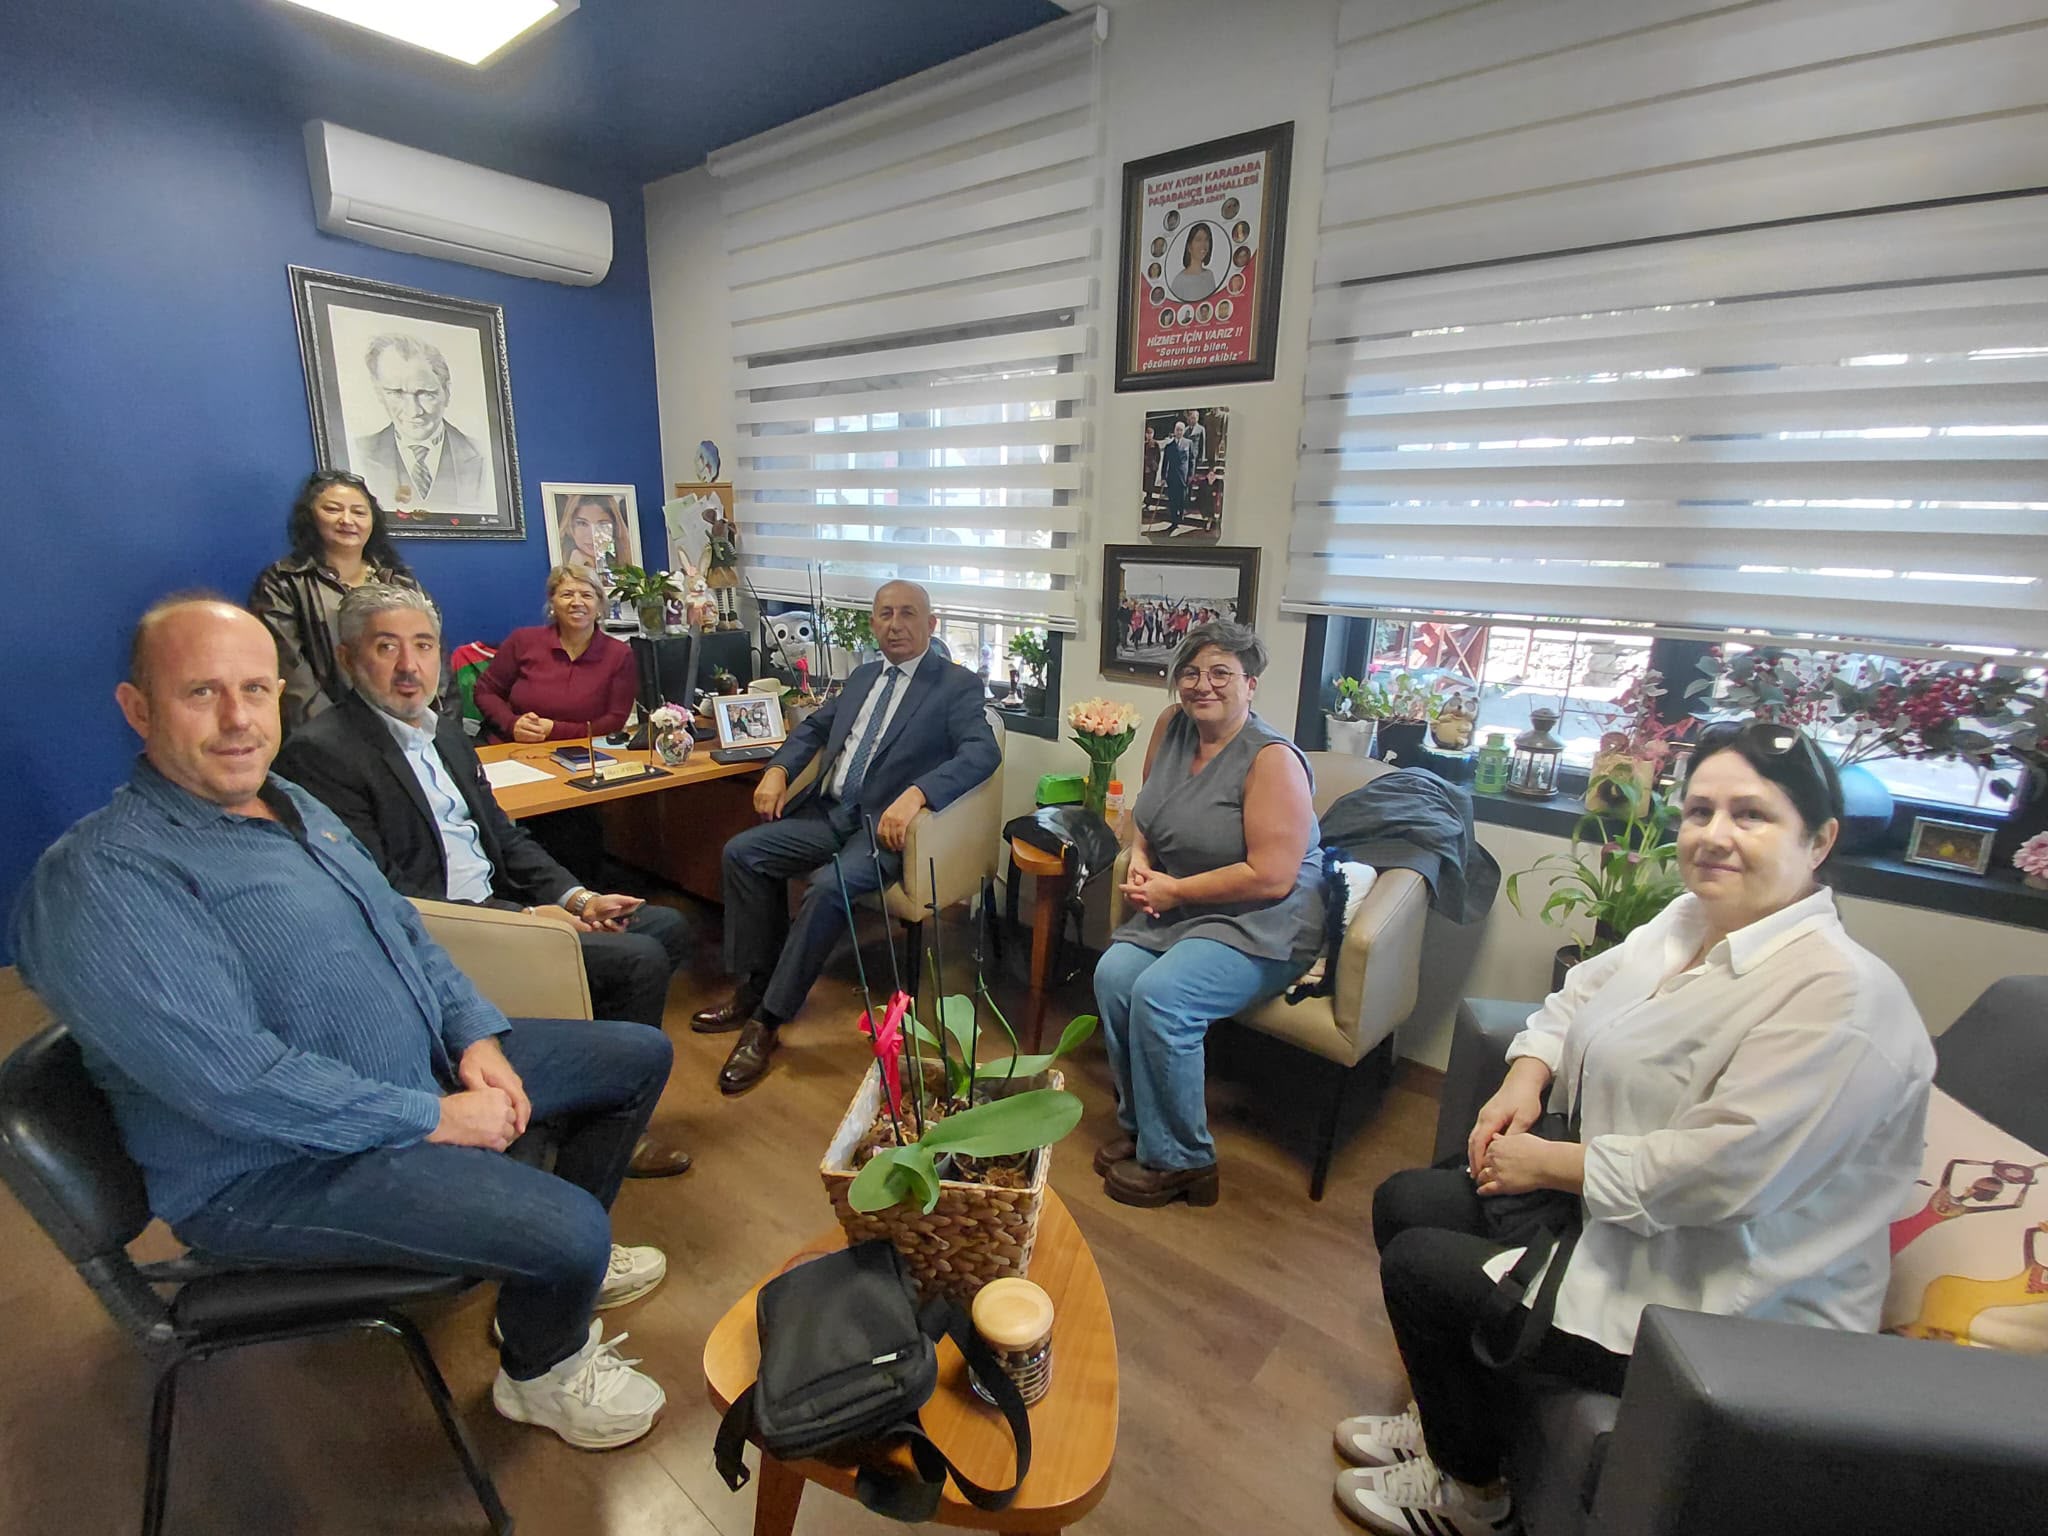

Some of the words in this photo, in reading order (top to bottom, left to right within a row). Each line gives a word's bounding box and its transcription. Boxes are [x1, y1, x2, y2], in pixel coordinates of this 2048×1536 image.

[1175, 173, 1203, 189] AYDIN
[1205, 160, 1261, 182] KARABABA
[1147, 334, 1182, 347] HİZMET
[1183, 330, 1203, 345] İÇİN
[1205, 327, 1234, 340] VARIZ
[1187, 355, 1207, 365] olan
